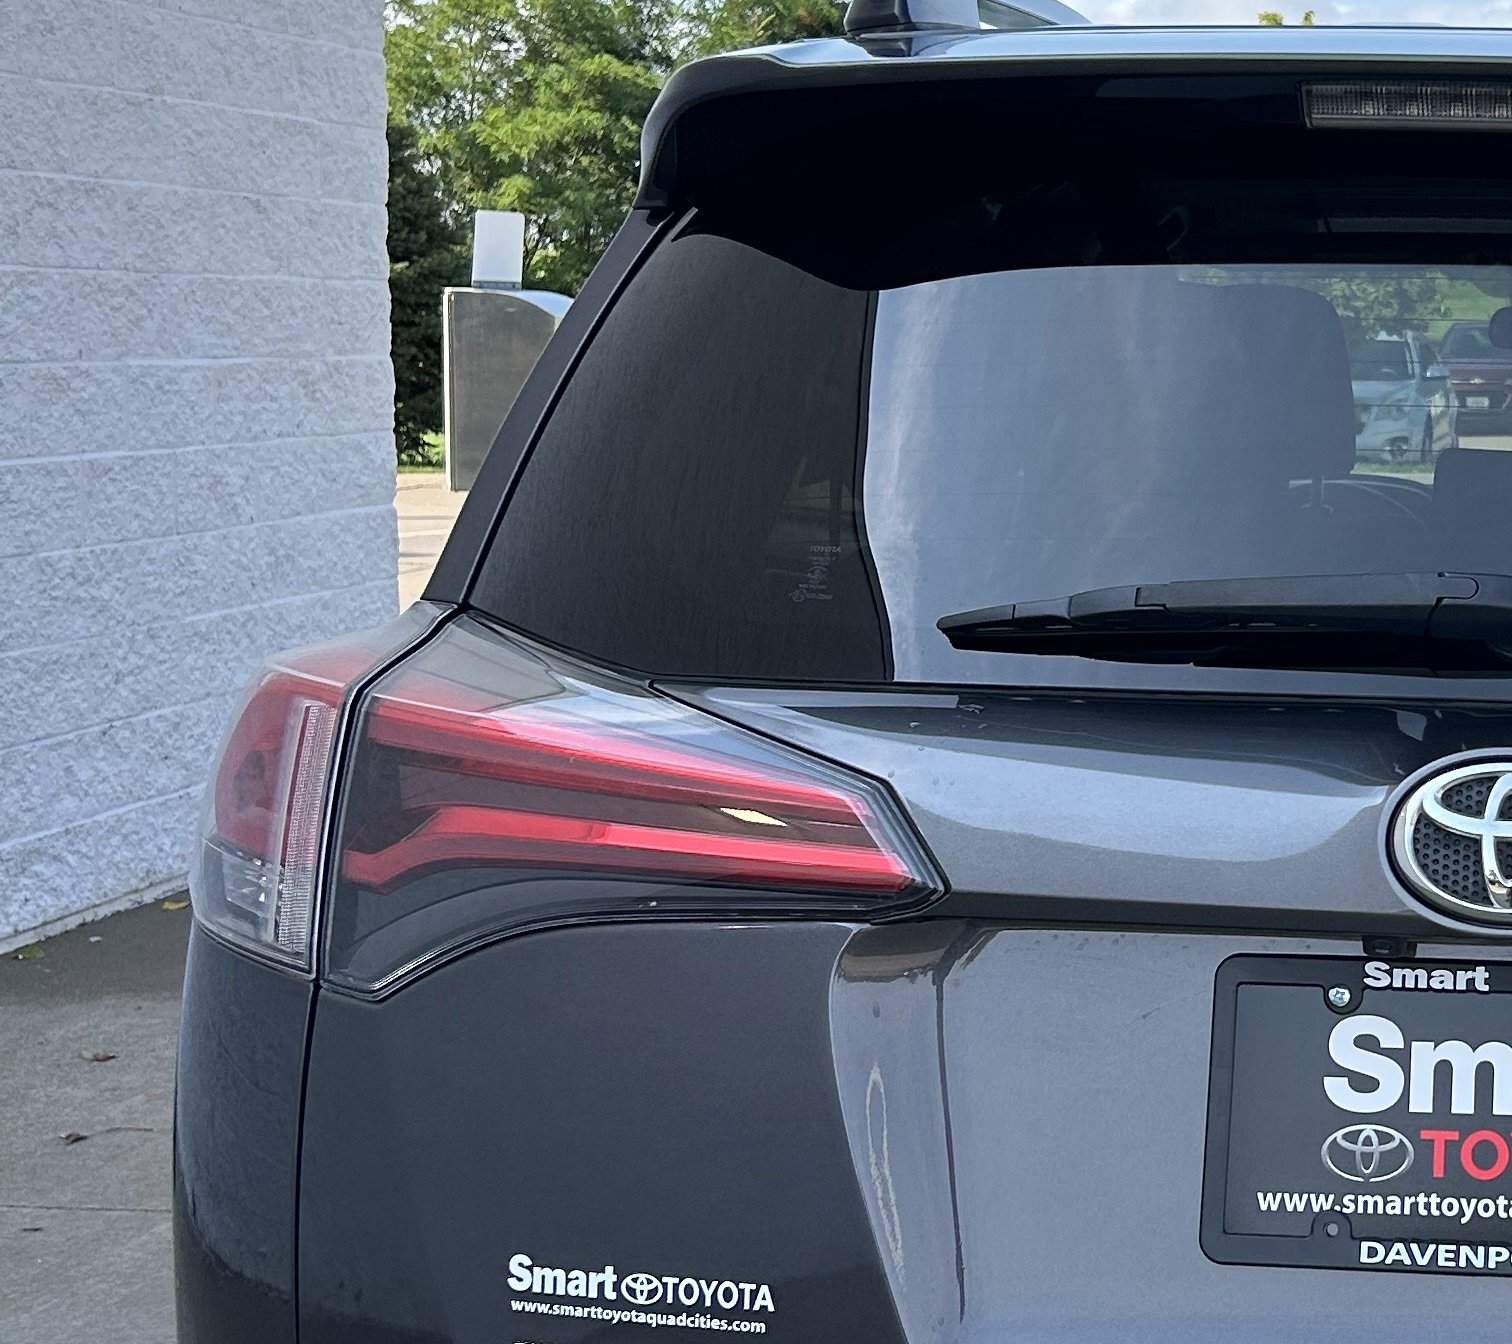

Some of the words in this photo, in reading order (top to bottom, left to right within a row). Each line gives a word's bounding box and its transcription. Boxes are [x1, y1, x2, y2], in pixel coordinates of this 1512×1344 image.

[1363, 961, 1491, 993] Smart
[507, 1253, 618, 1301] Smart
[662, 1276, 775, 1312] TOYOTA
[510, 1300, 767, 1334] www.smarttoyotaquadcities.com
